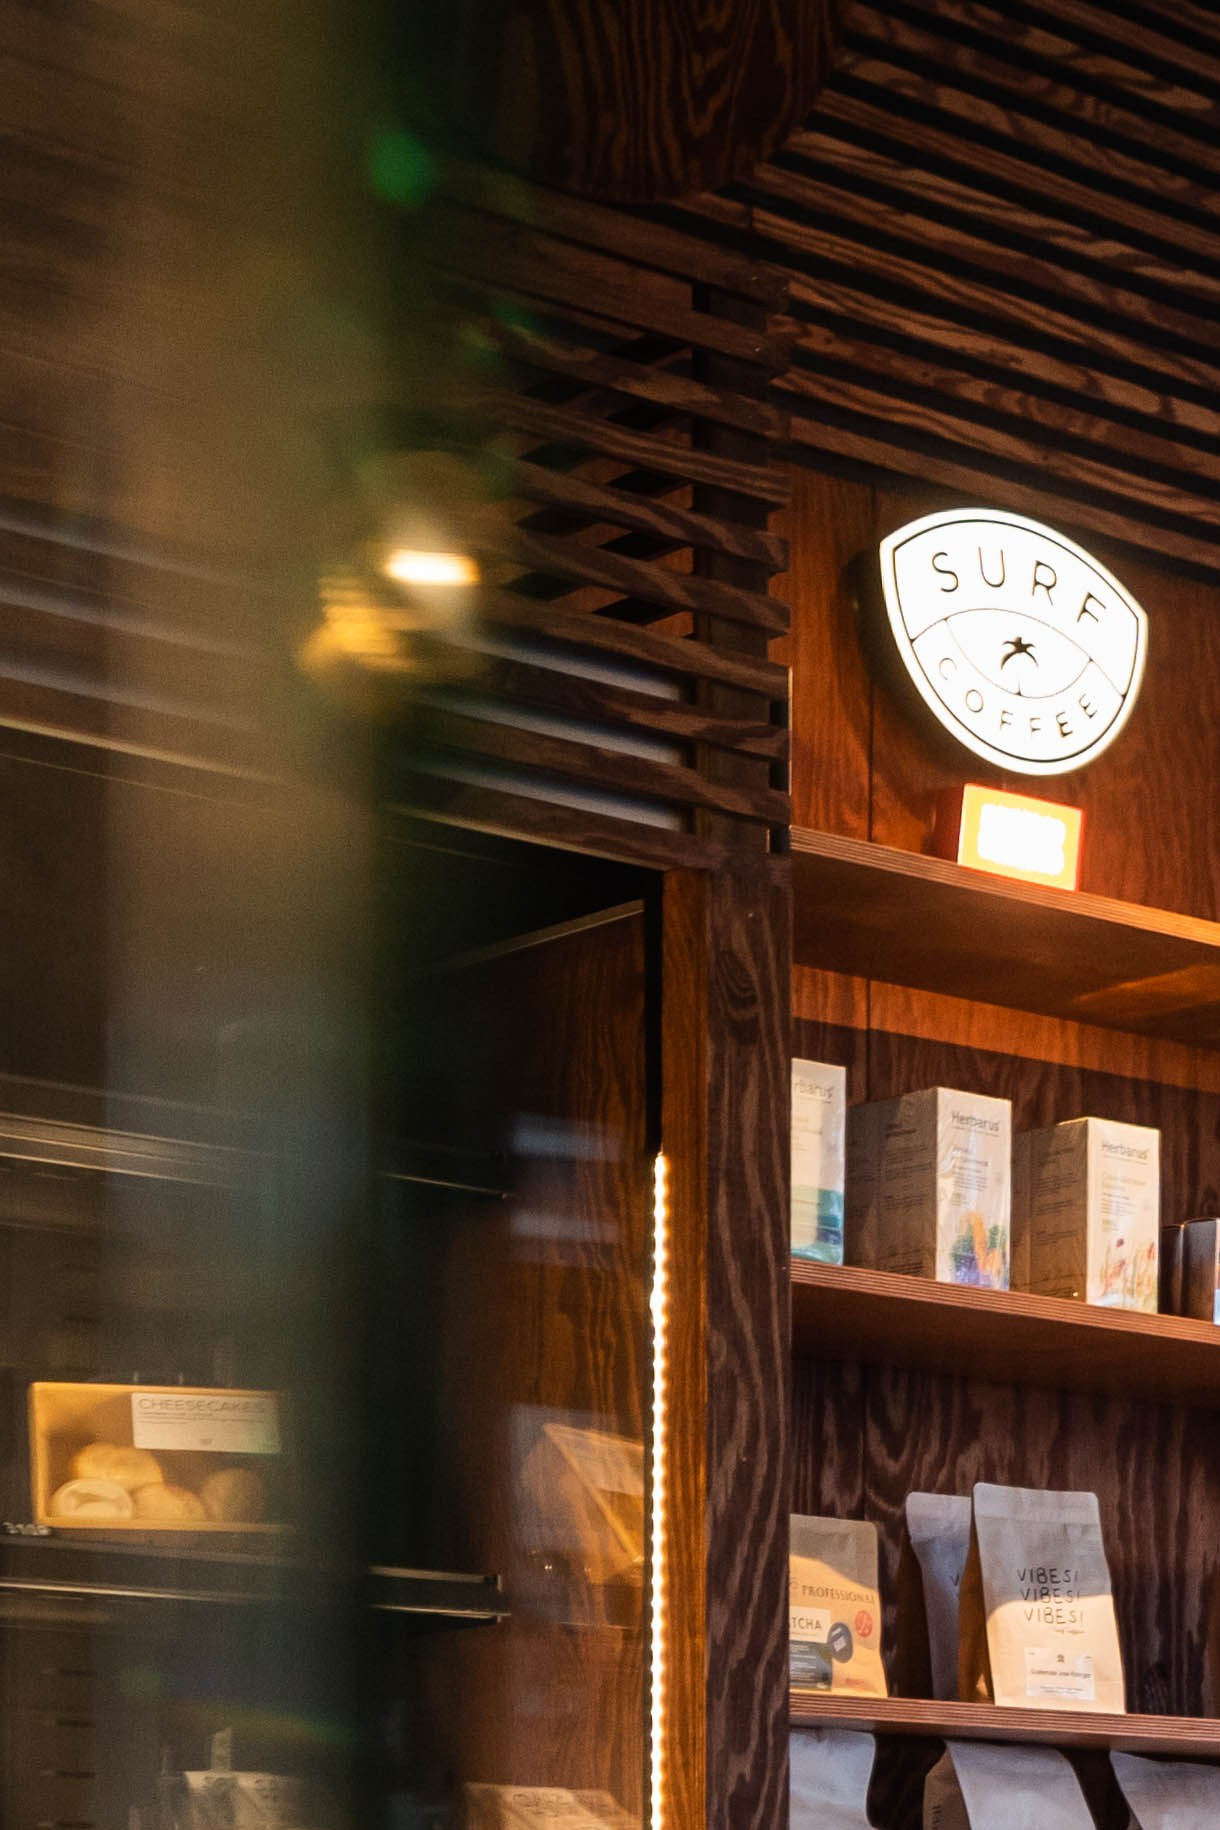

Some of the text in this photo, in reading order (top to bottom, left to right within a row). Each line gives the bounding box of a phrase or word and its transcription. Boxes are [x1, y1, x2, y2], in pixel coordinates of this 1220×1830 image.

[930, 545, 1107, 625] SURF
[938, 656, 1099, 740] COFFEE
[951, 1110, 1000, 1132] Herbarus
[791, 1617, 822, 1631] TCHA
